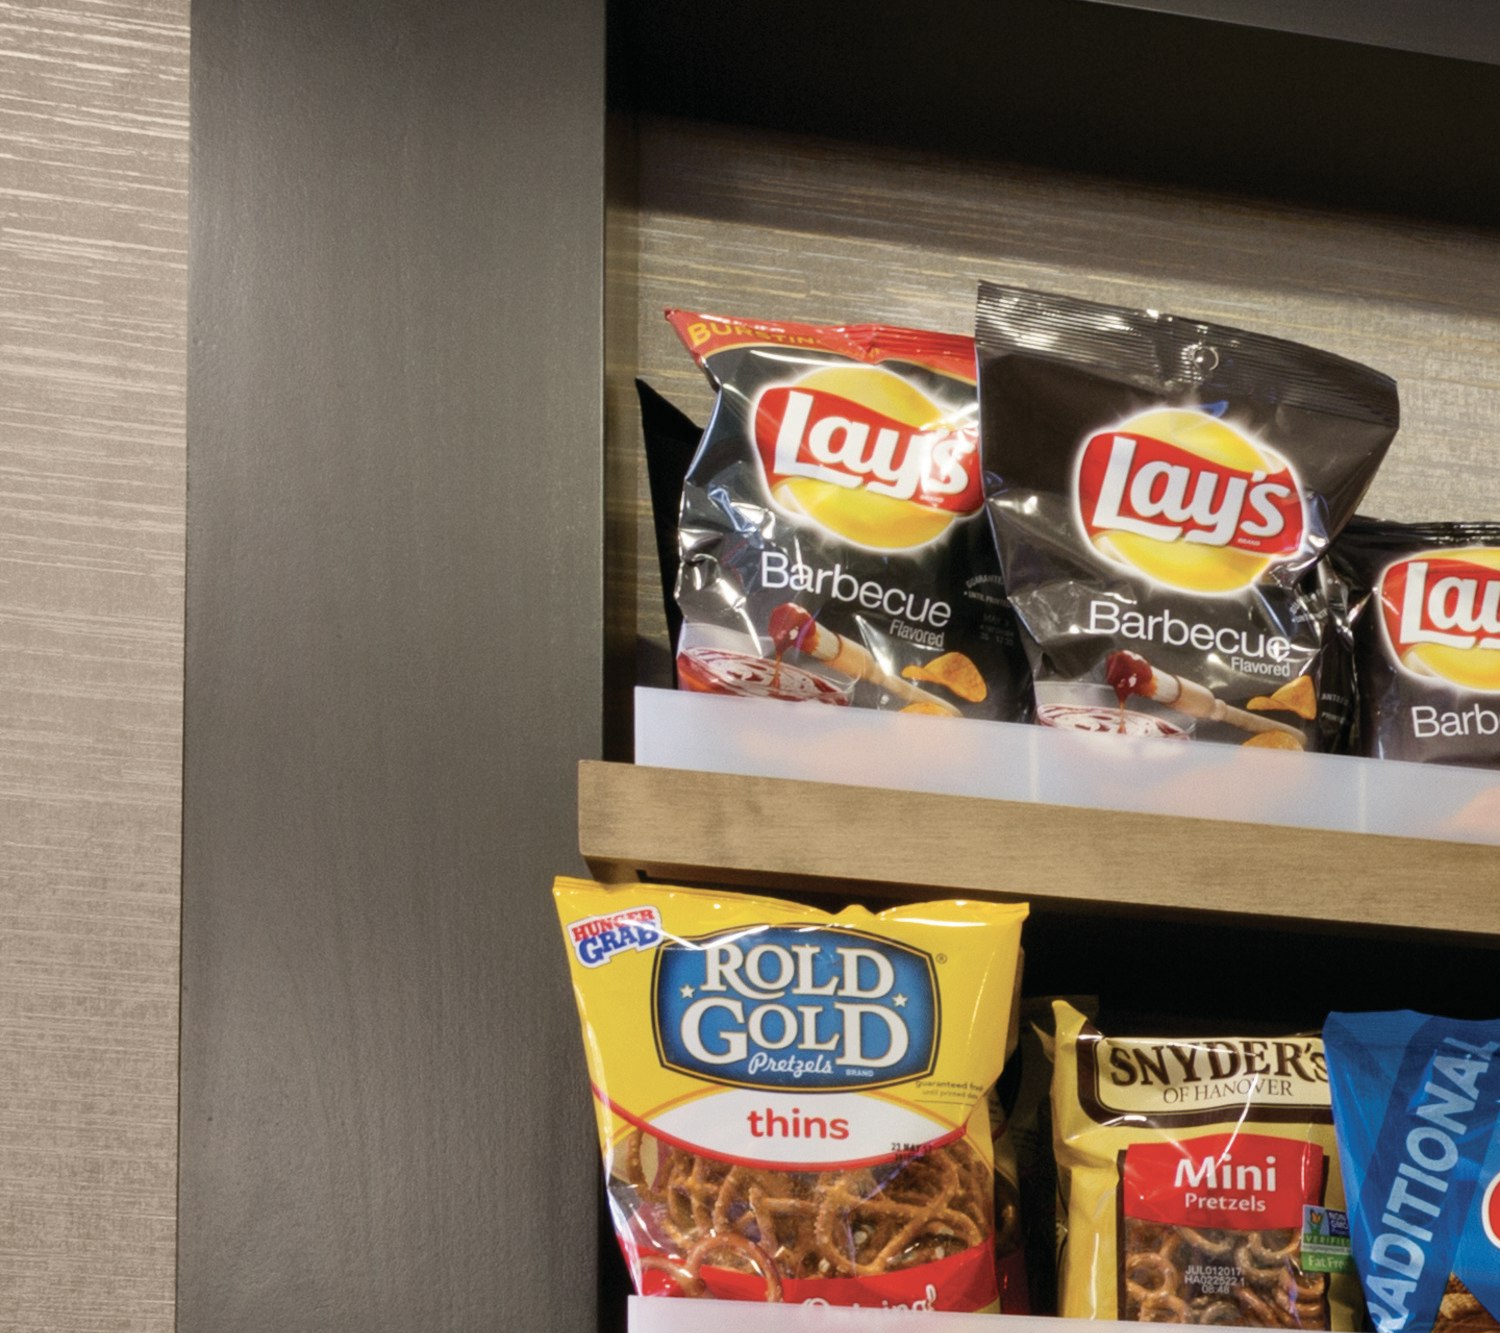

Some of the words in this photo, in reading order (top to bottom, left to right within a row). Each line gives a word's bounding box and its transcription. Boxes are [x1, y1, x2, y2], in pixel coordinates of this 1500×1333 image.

[1092, 436, 1290, 547] Lay's
[761, 552, 951, 628] Barbecue
[890, 621, 944, 648] Flavored
[1089, 601, 1290, 659] Barbecue
[1231, 656, 1291, 677] Flavored
[577, 924, 661, 964] GRAB
[700, 942, 893, 1000] ROLD
[679, 997, 909, 1068] GOLD
[748, 1052, 833, 1076] Pretzels
[1163, 1086, 1184, 1104] OF
[1195, 1079, 1293, 1098] HANOVER
[747, 1109, 850, 1140] thins
[1174, 1154, 1276, 1191] Mini
[1185, 1193, 1266, 1212] Pretzels
